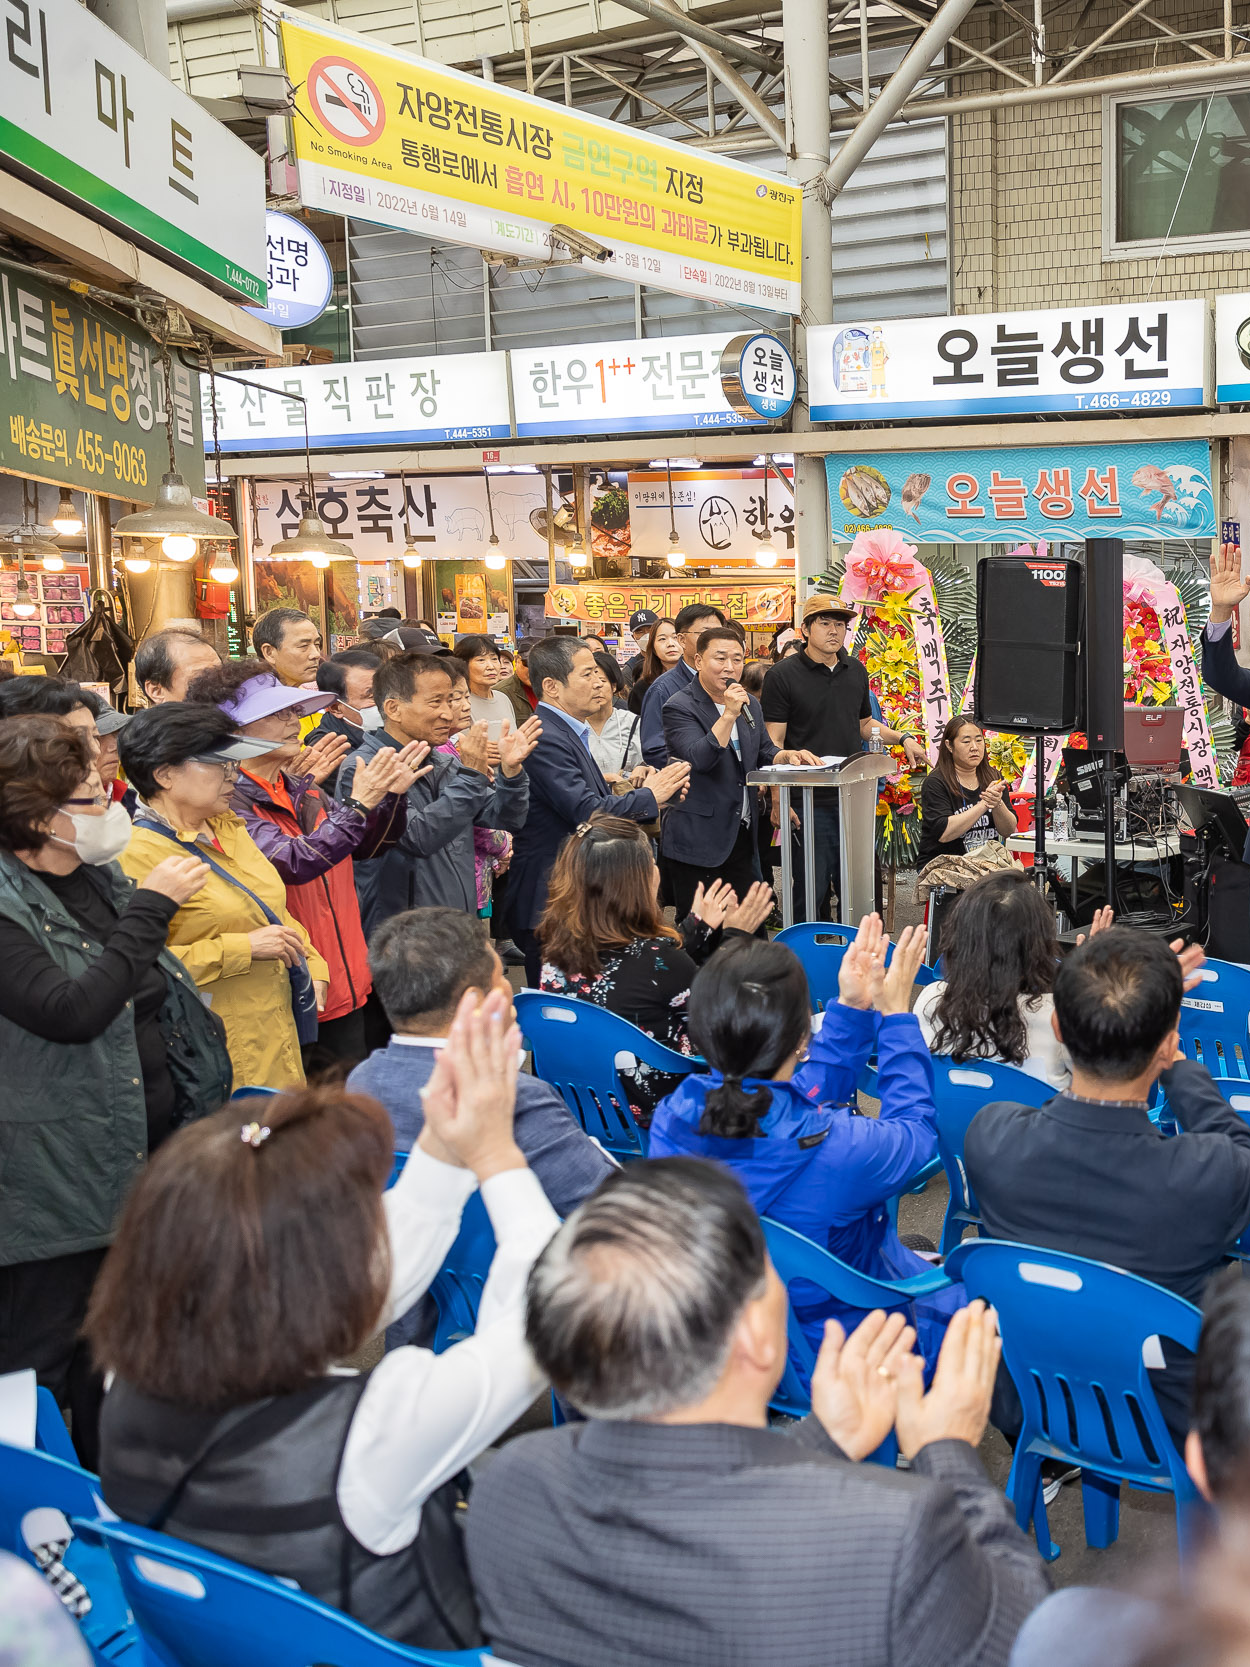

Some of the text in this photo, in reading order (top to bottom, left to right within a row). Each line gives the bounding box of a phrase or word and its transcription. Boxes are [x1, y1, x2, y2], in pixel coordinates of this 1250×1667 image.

[310, 141, 393, 171] No Smoking Area
[396, 82, 704, 204] 자양전통시장 금연구역 지정
[376, 192, 418, 216] 2022년
[421, 203, 440, 222] 6월
[442, 208, 467, 228] 14일
[401, 138, 498, 189] 통행로에서
[505, 165, 545, 201] 흡연
[581, 187, 656, 231] 10만원의
[661, 208, 723, 247] 과태료가
[727, 229, 794, 266] 부과됩니다.
[769, 188, 796, 205] 광진구
[495, 220, 534, 244] 계도기간
[642, 256, 661, 274] 12일
[683, 266, 707, 284] 단속일
[714, 273, 742, 292] 2022년
[743, 280, 756, 294] 8월
[753, 346, 784, 369] 오늘
[932, 313, 1169, 388] 오늘생선
[752, 373, 785, 397] 생선
[761, 398, 777, 412] 생선
[1075, 390, 1172, 410] T.466-4829
[444, 427, 492, 440] T.444-5351
[75, 428, 148, 488] 455-9063
[945, 466, 1122, 520] 오늘생선
[1031, 569, 1064, 580] 1100
